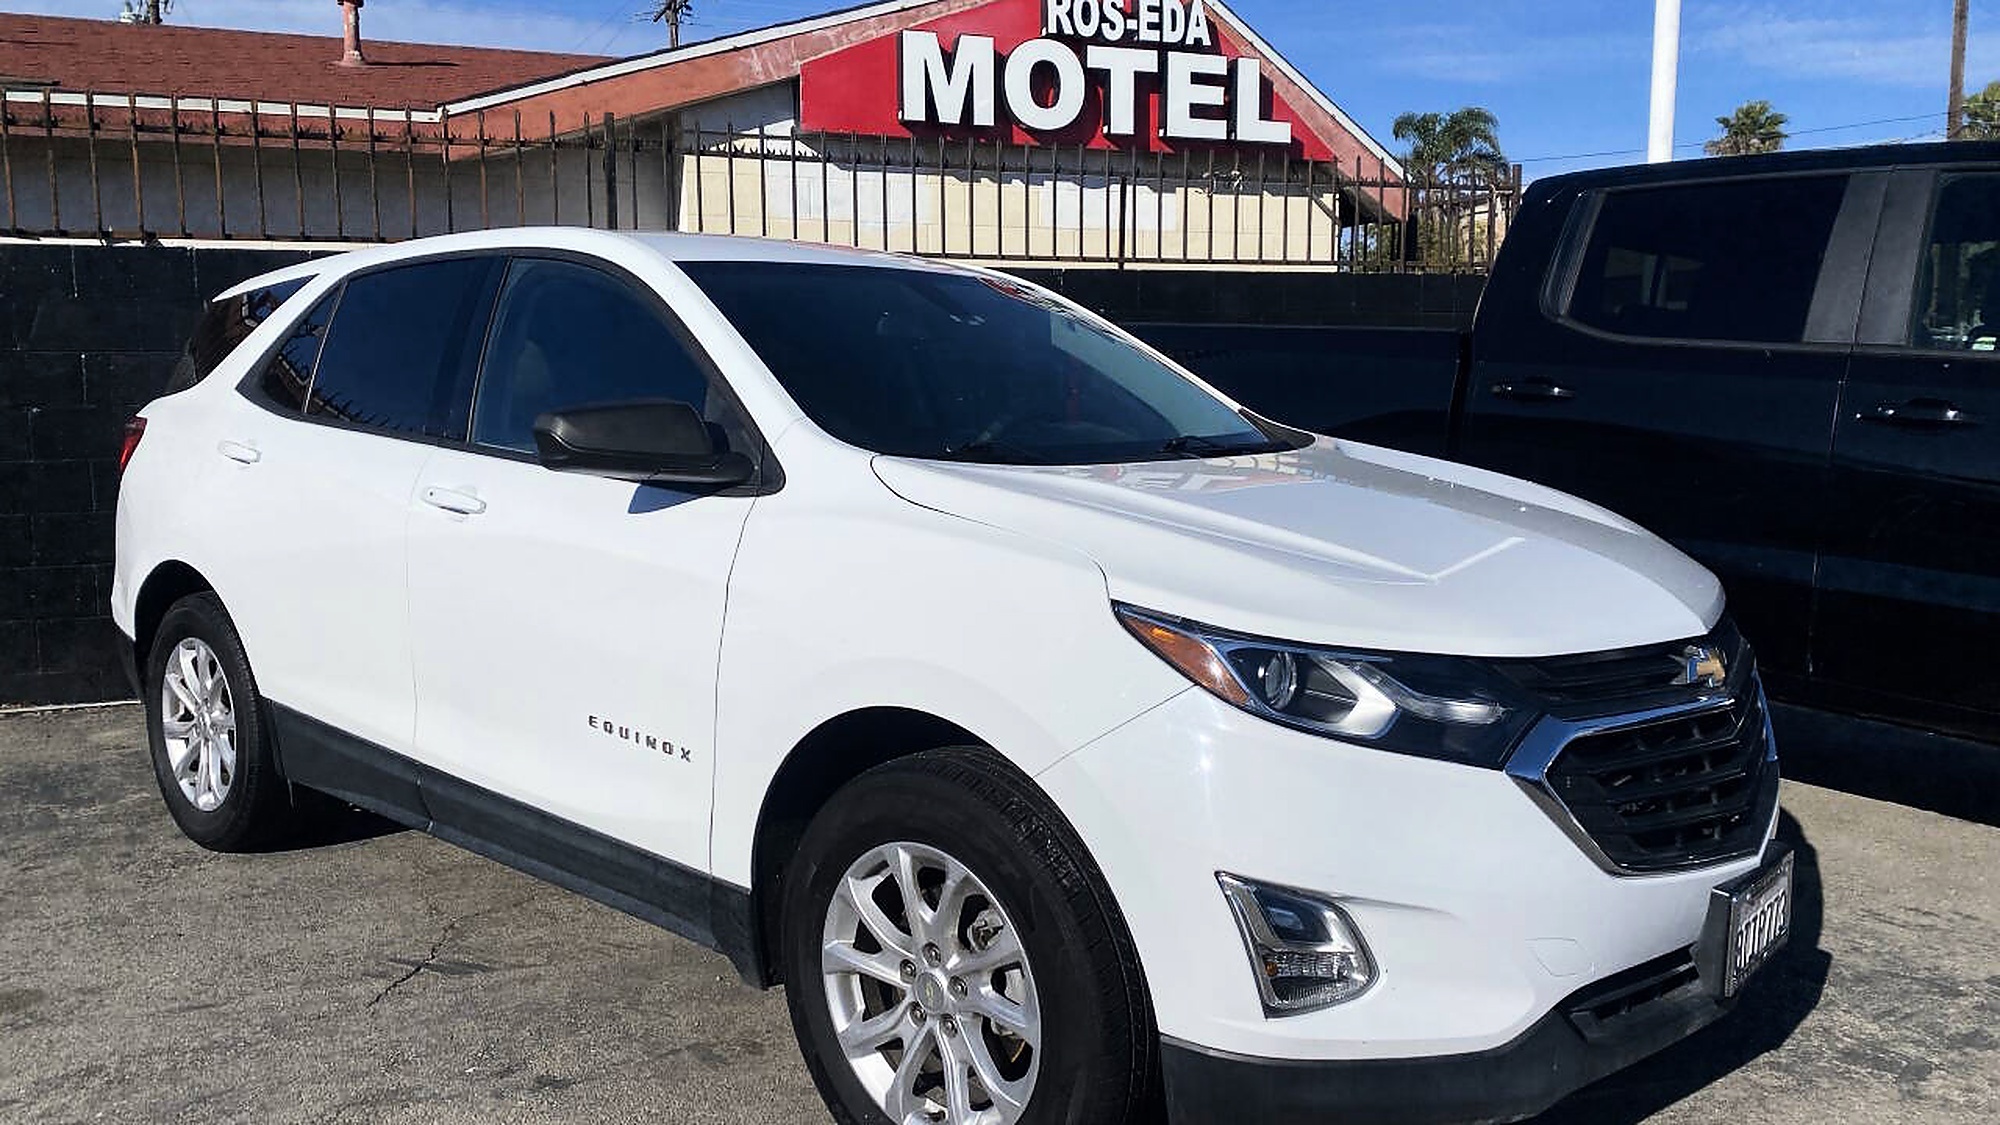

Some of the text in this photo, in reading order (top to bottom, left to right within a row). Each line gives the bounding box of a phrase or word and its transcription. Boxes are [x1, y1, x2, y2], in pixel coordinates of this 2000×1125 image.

[1047, 0, 1211, 46] ROS-EDA
[901, 29, 1292, 144] MOTEL
[588, 715, 691, 762] EQUINOX
